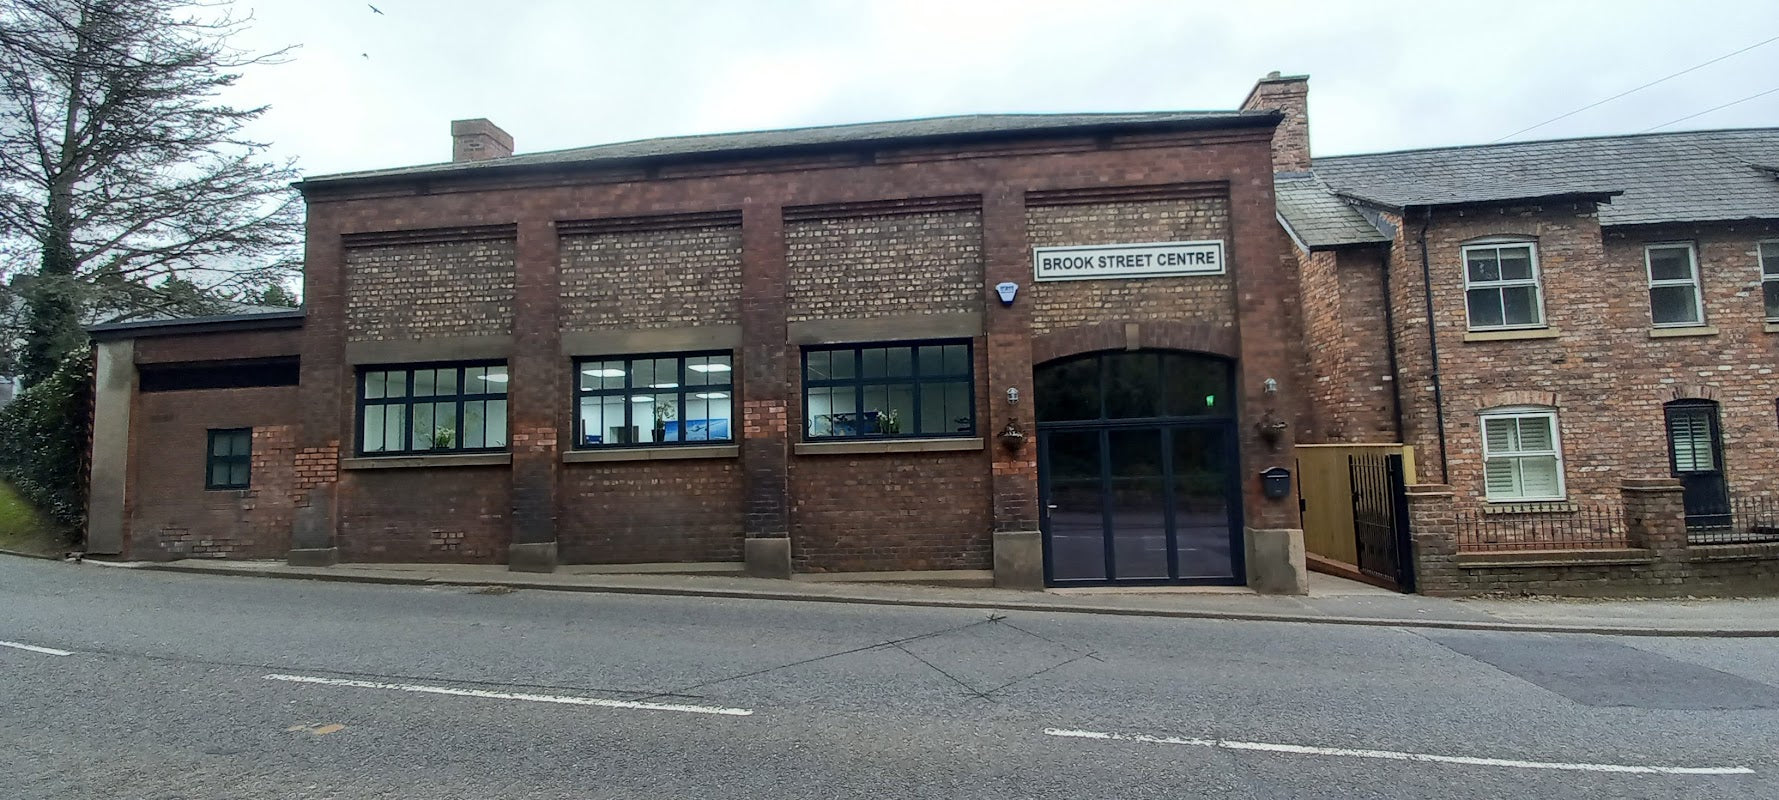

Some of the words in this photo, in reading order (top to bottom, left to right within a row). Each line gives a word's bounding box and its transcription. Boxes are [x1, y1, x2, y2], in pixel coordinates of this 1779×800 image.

[1043, 256, 1095, 271] BROOK
[1098, 254, 1152, 269] STREET
[1157, 251, 1215, 266] CENTRE
